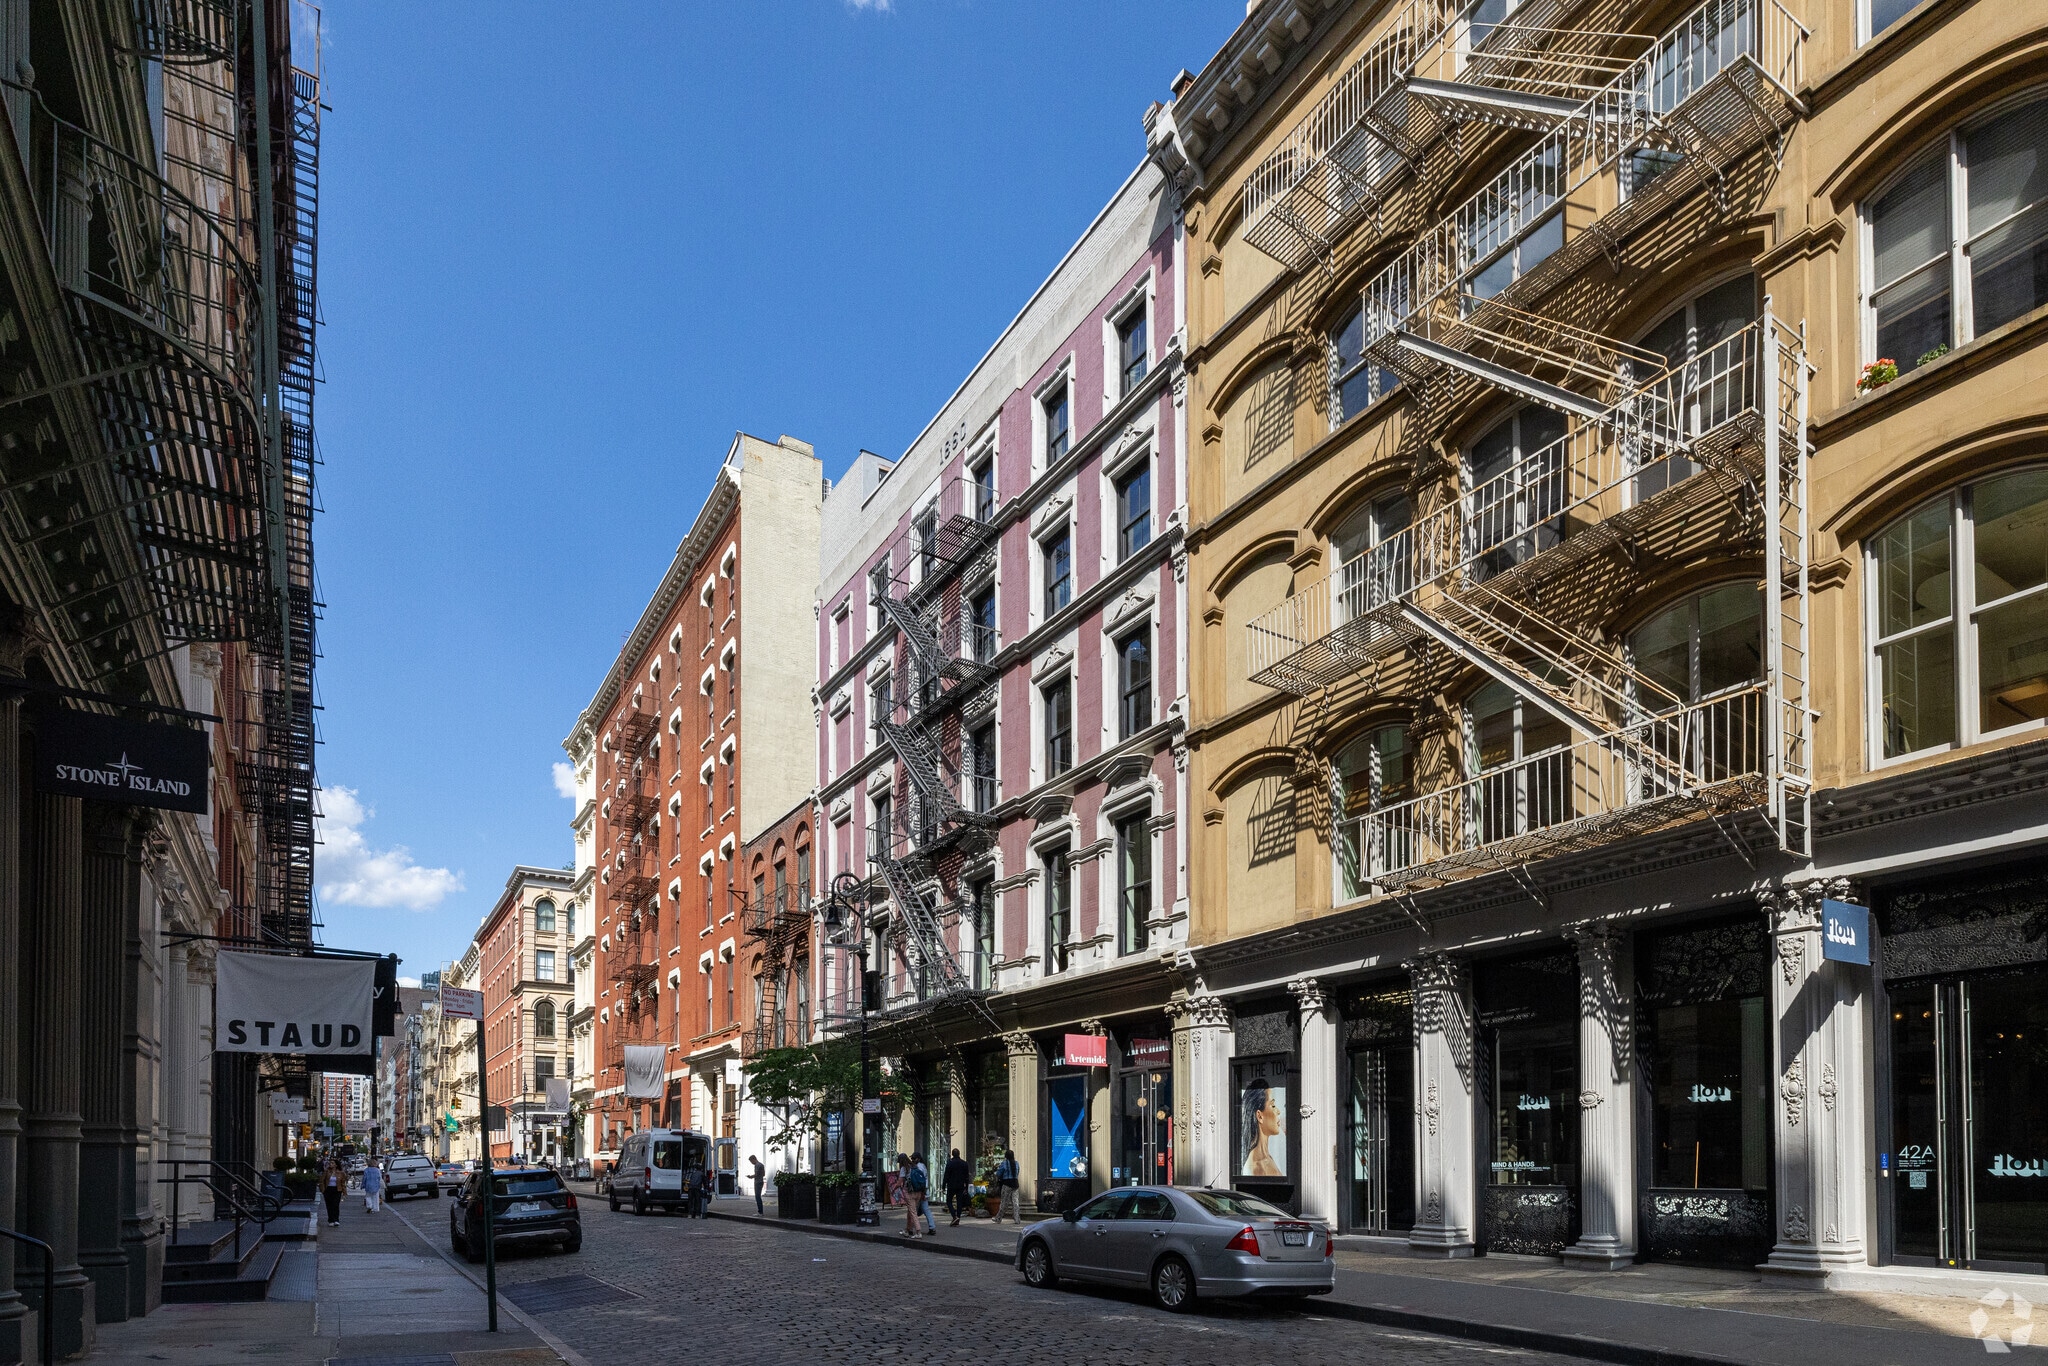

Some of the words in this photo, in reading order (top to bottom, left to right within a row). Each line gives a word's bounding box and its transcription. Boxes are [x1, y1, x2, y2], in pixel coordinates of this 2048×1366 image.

[56, 764, 120, 787] STONE
[129, 775, 191, 796] ISLAND
[452, 990, 475, 999] PARKING
[228, 1019, 362, 1048] STAUD
[1068, 1053, 1106, 1064] Artemide
[1250, 1062, 1266, 1078] THE
[1898, 1144, 1937, 1159] 42A
[1513, 1160, 1535, 1168] HANDS
